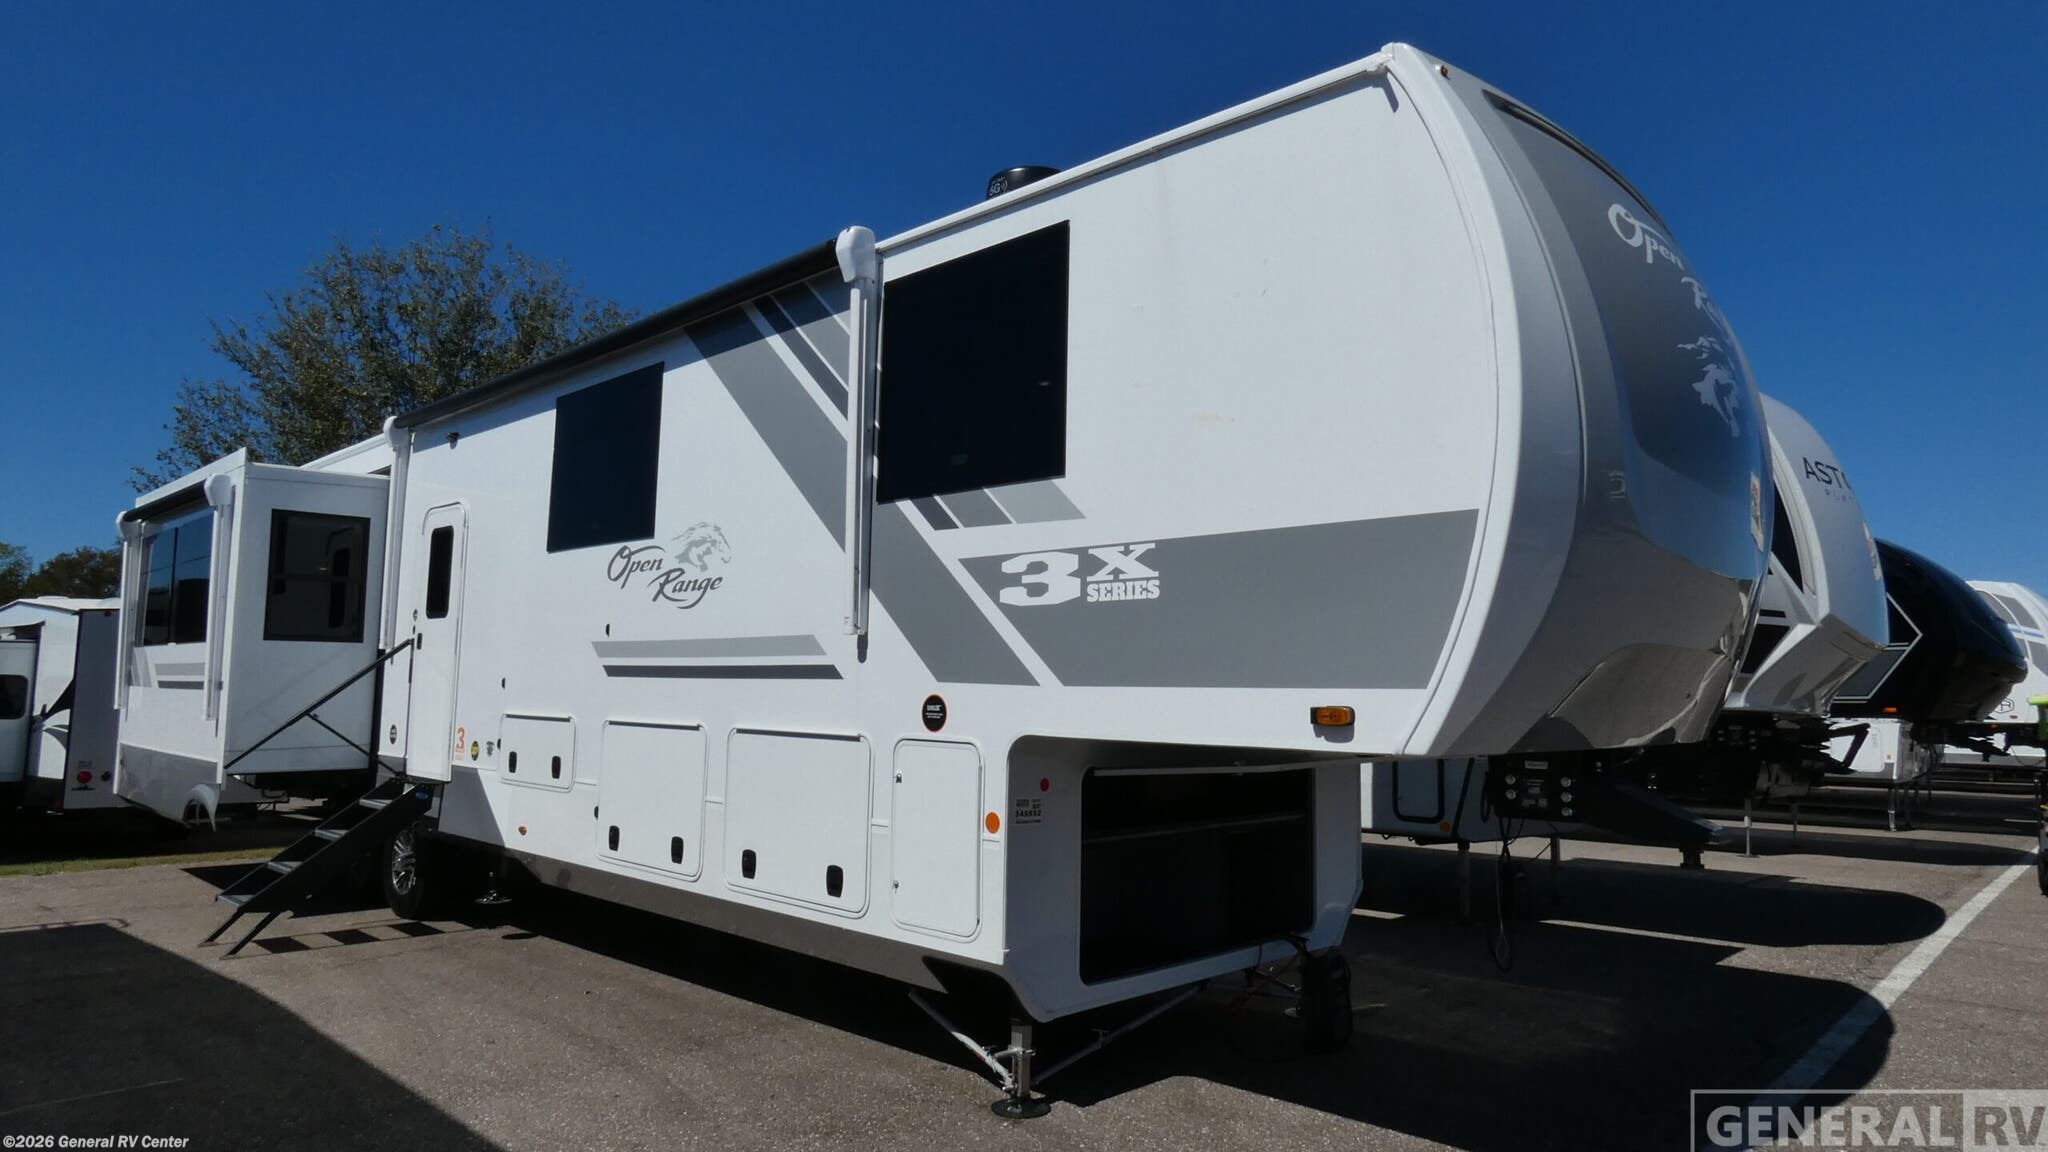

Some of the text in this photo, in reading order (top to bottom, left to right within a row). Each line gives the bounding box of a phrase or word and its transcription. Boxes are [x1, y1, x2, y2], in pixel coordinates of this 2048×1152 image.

[1608, 203, 1685, 271] Open
[607, 545, 666, 590] Open
[647, 567, 723, 609] Range
[1086, 580, 1160, 603] SERIES
